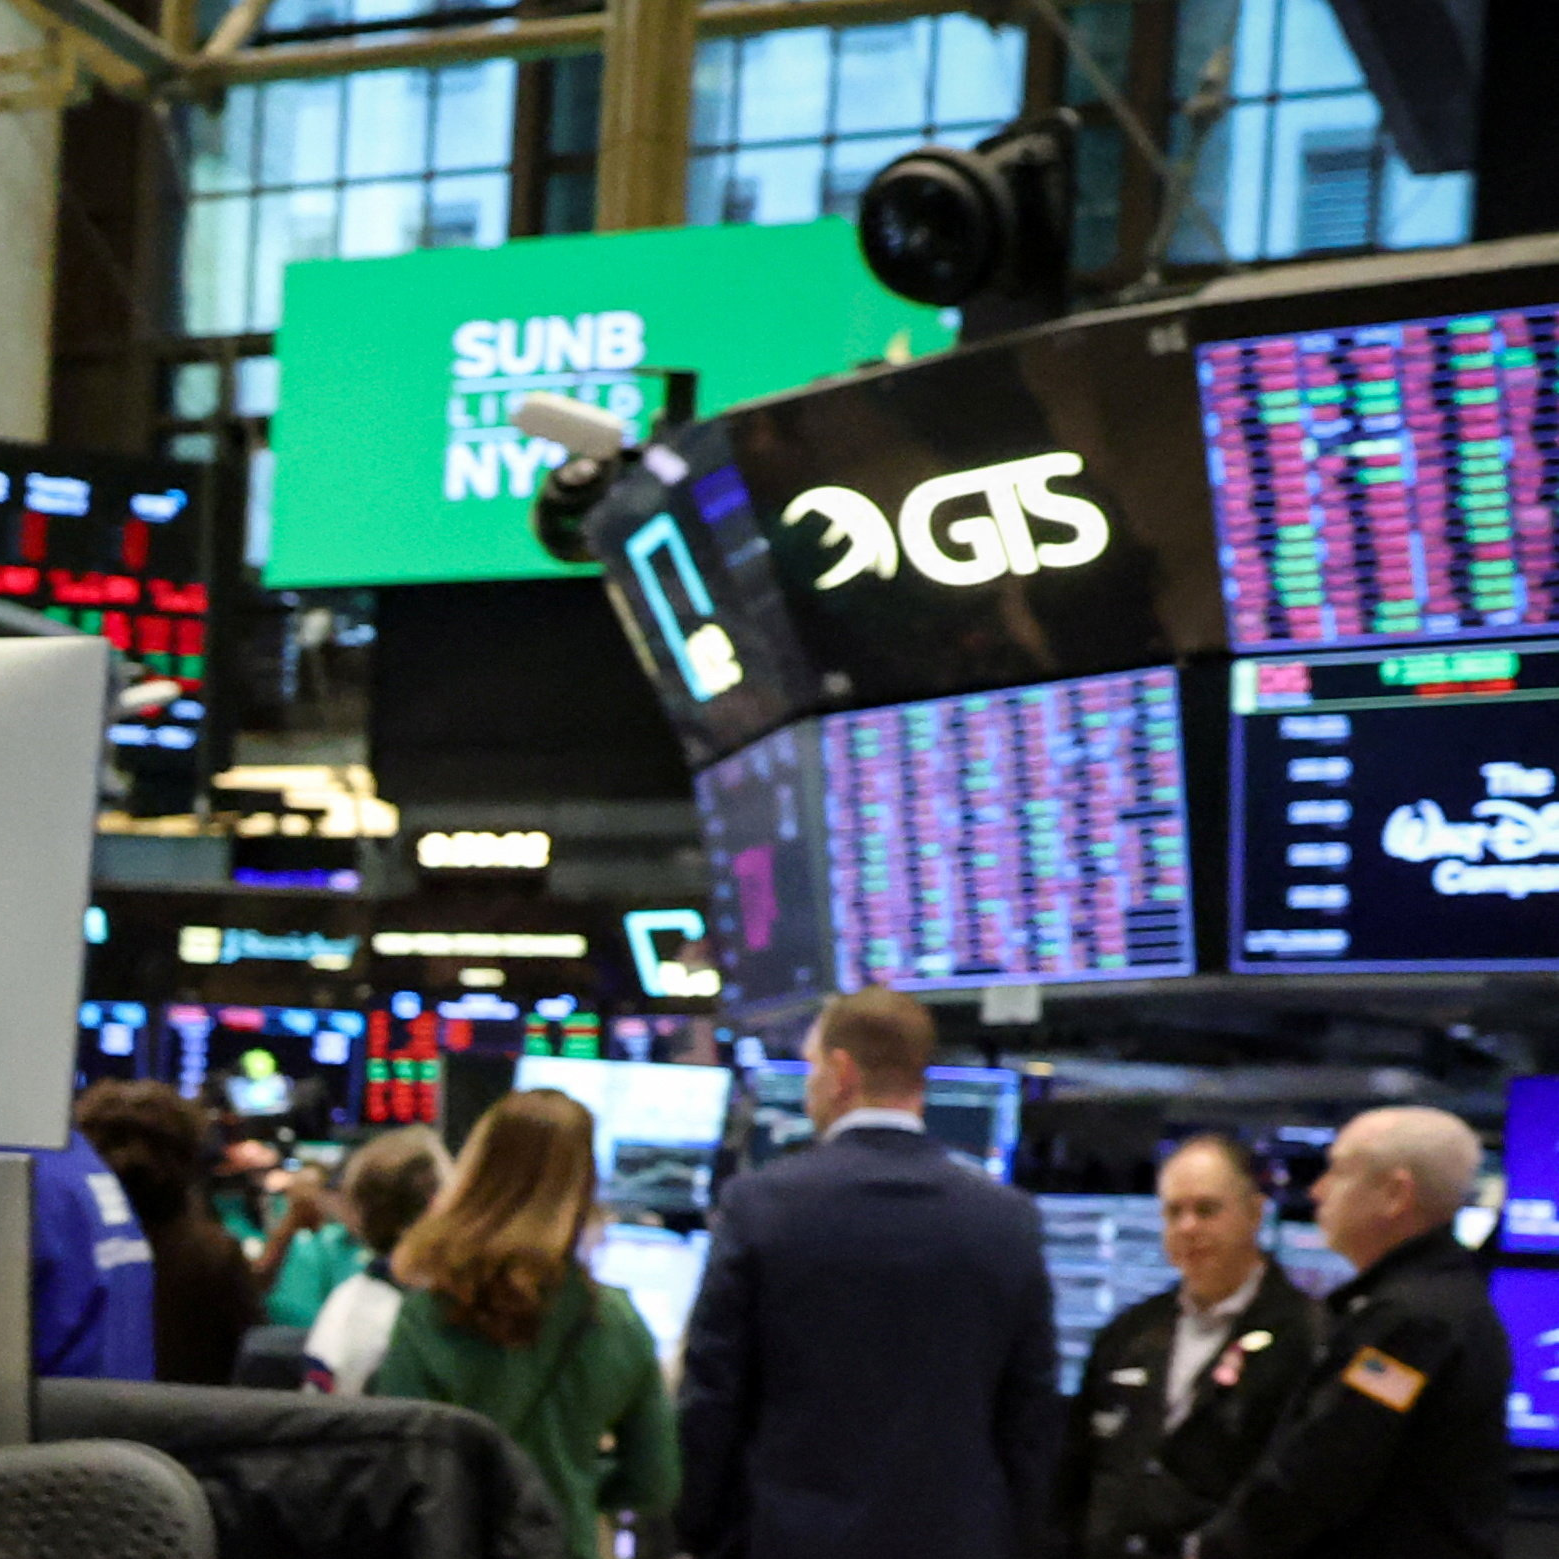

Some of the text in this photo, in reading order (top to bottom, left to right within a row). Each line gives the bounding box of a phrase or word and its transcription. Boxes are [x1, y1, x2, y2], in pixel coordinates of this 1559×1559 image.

[452, 310, 646, 378] SUNB
[445, 433, 572, 500] NY
[898, 451, 1110, 587] GTS
